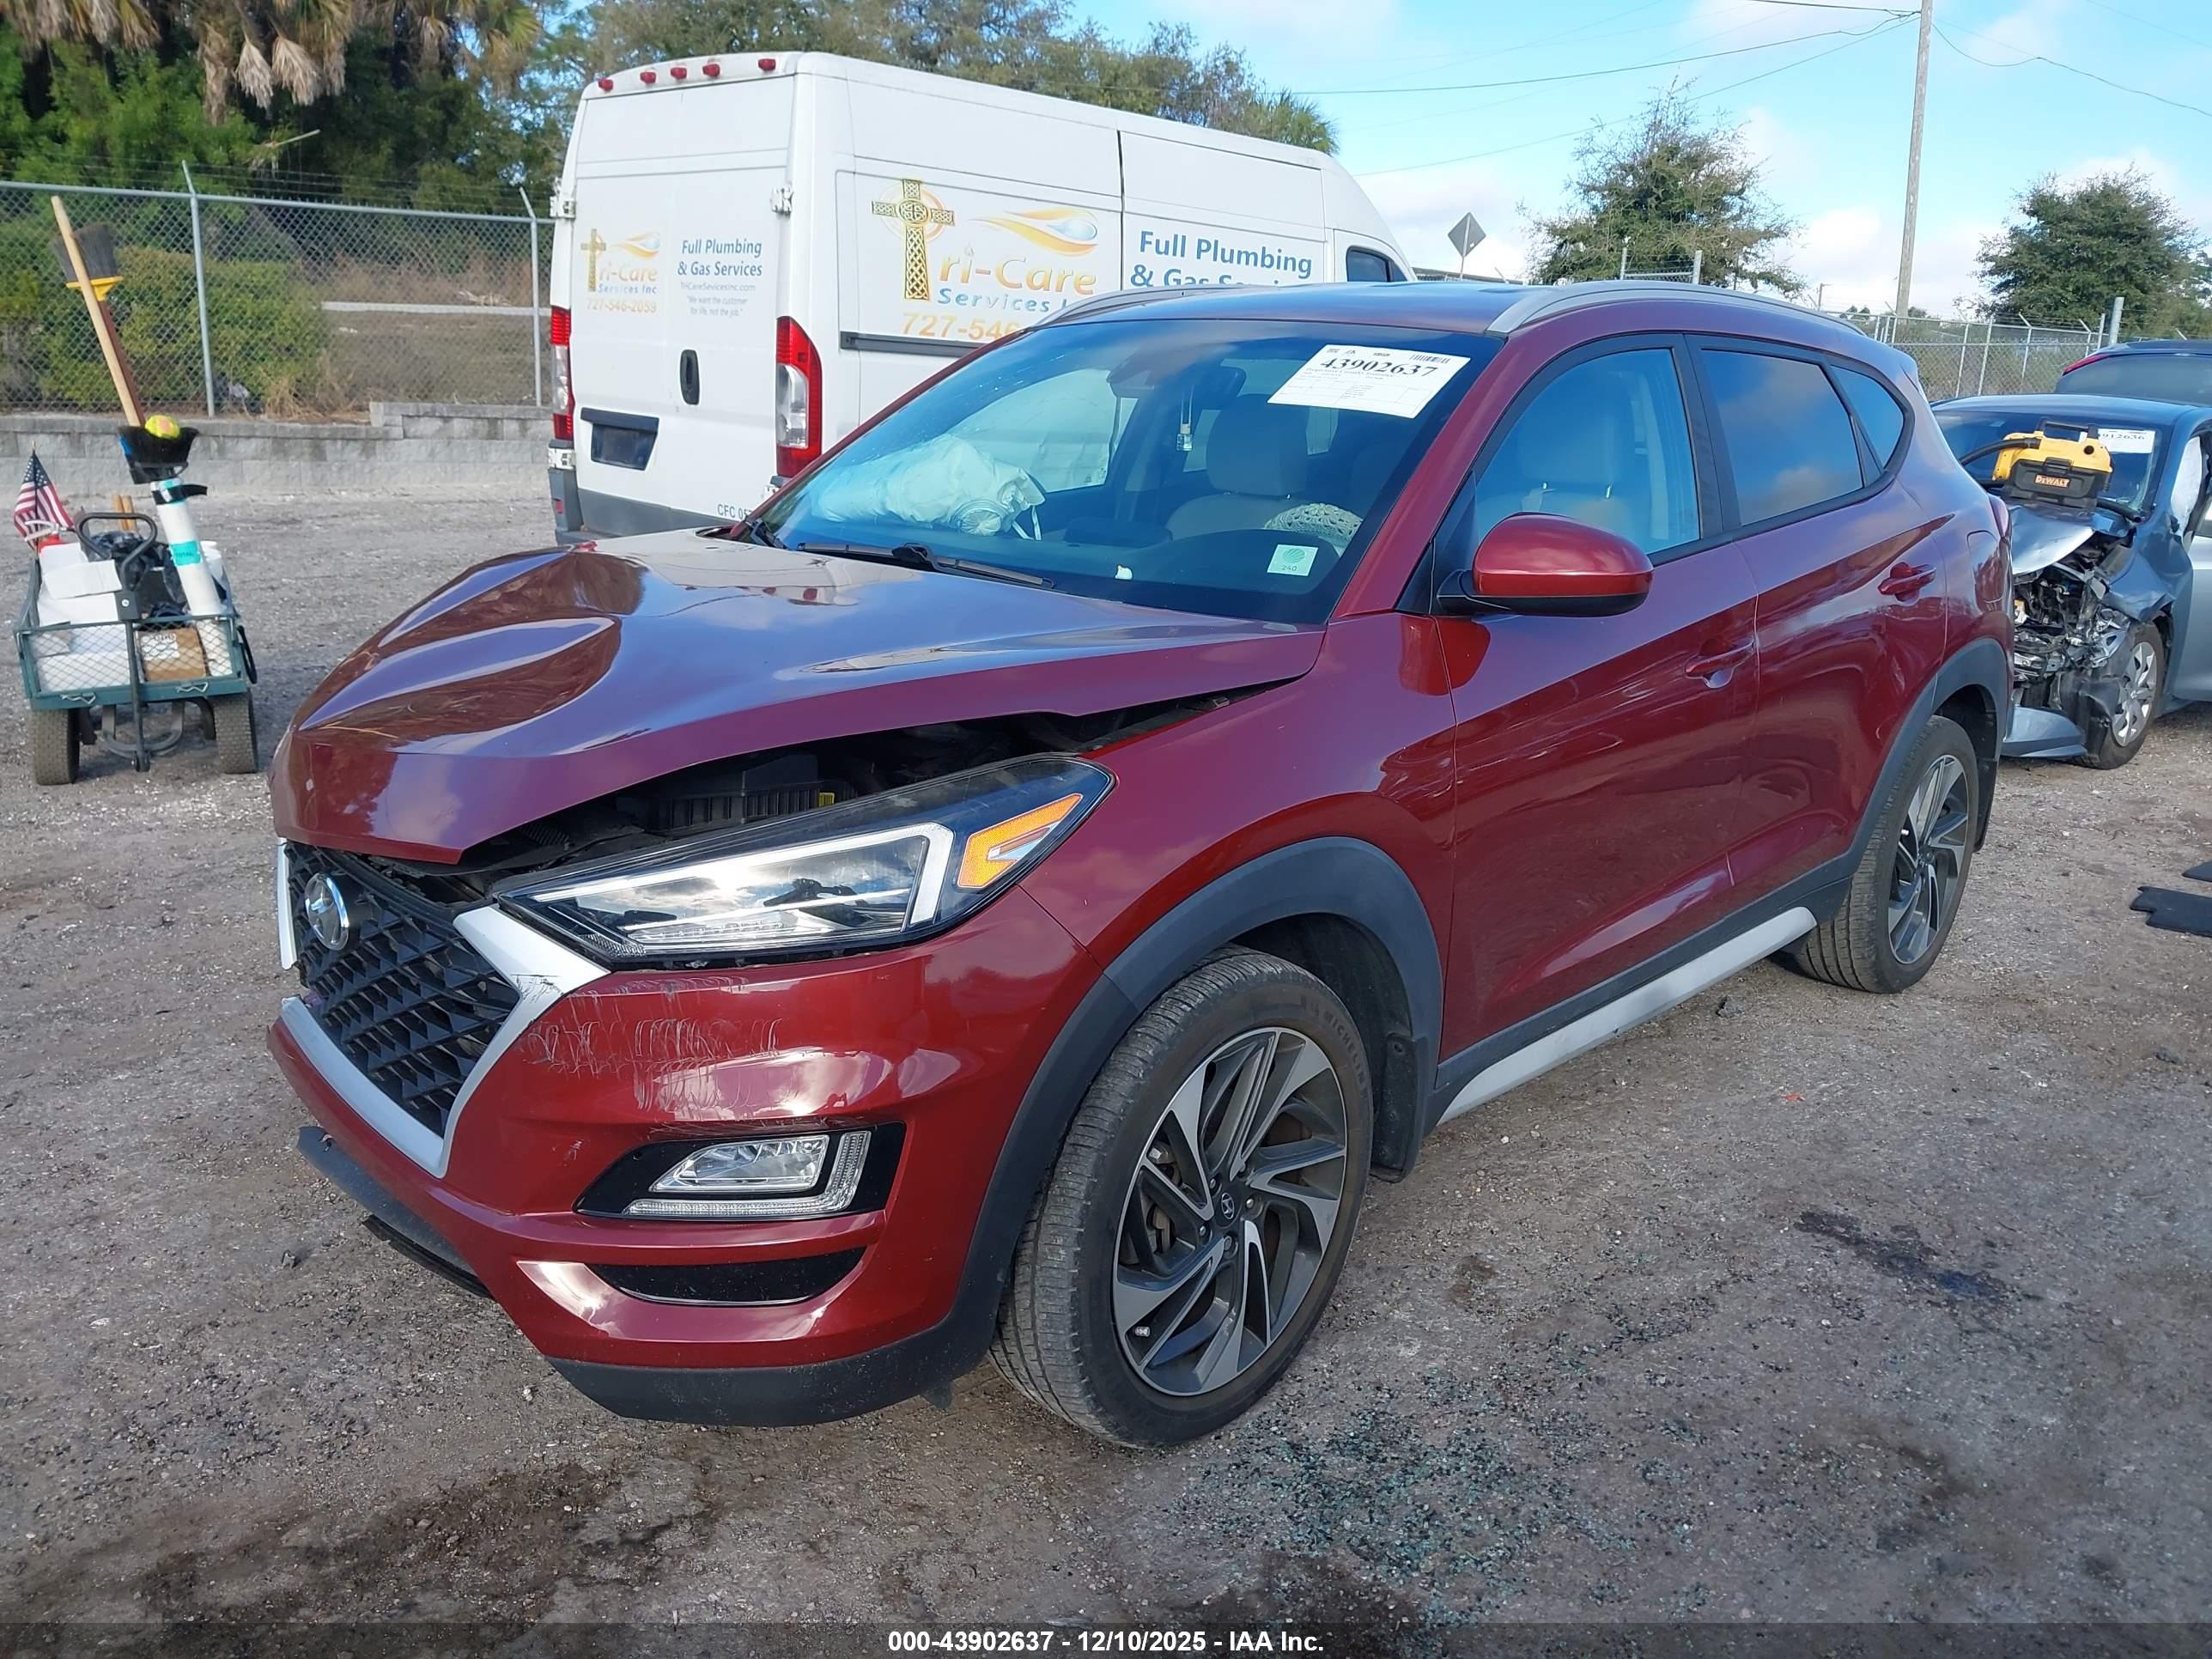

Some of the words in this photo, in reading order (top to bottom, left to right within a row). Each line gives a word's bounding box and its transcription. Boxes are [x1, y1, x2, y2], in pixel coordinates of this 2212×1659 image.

[681, 239, 702, 255] Full
[705, 238, 763, 258] Plumbing
[1139, 229, 1187, 258] Full
[1195, 238, 1312, 280] Plumbing
[677, 260, 687, 276] &
[690, 260, 711, 276] Gas
[714, 260, 763, 276] Services
[1130, 264, 1154, 288] &
[599, 283, 639, 295] Services
[642, 284, 658, 295] Inc
[937, 288, 1050, 313] Services
[1320, 357, 1439, 377] 43902637
[717, 503, 736, 519] CFC
